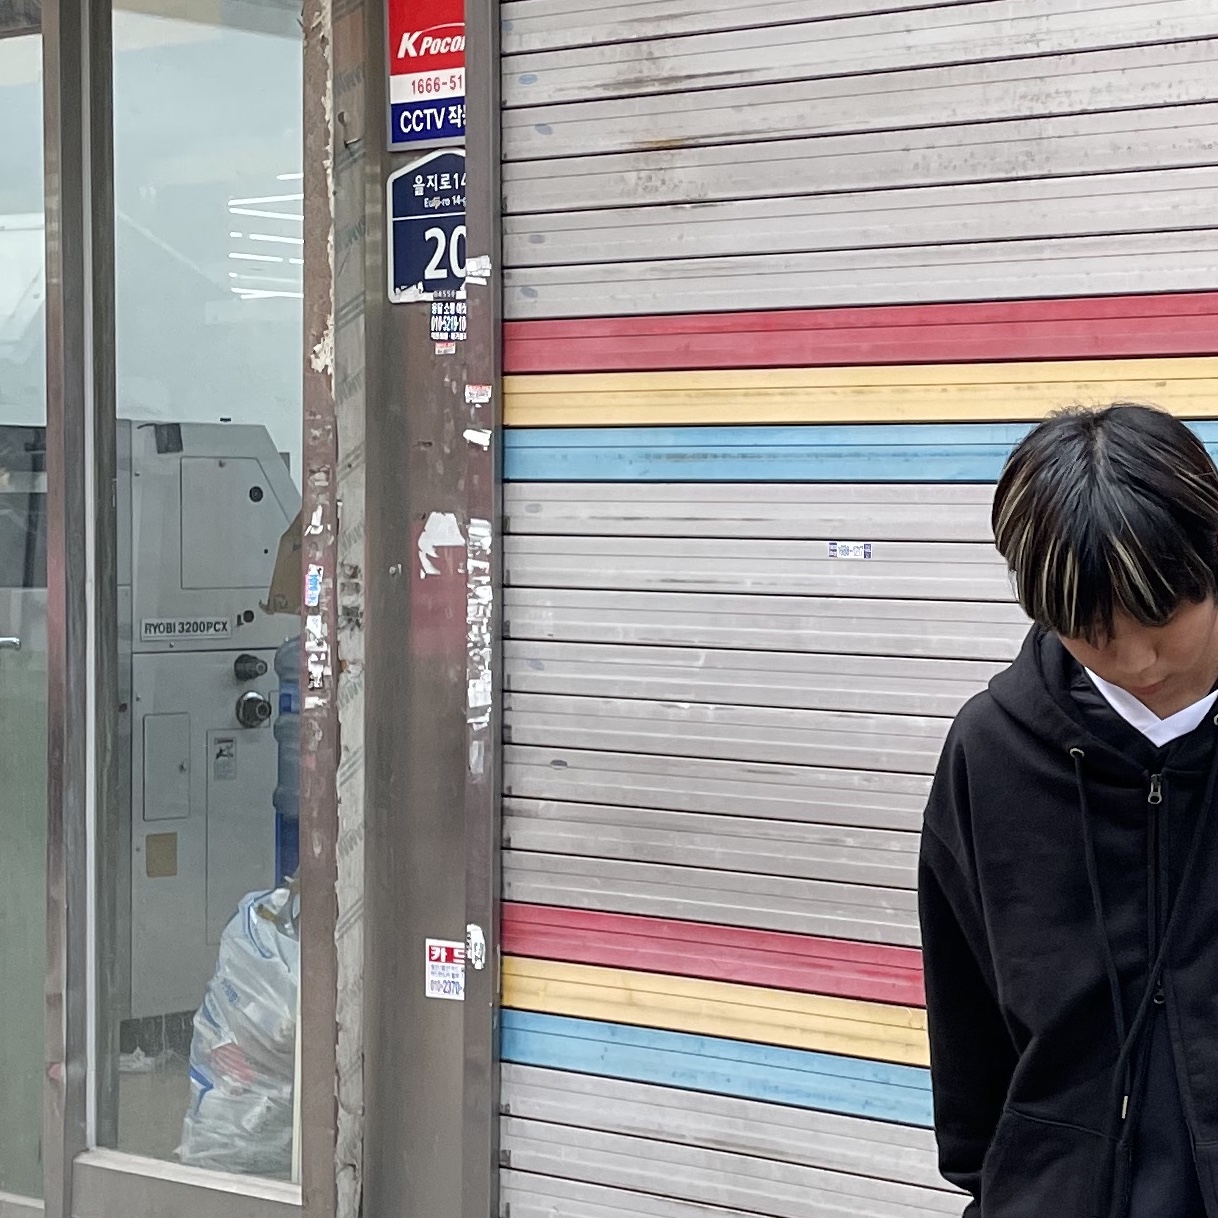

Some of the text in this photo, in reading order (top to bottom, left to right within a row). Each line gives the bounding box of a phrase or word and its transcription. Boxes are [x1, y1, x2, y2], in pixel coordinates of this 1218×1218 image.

[400, 107, 446, 133] CCTV
[144, 621, 228, 634] RYOBI 3200PCX
